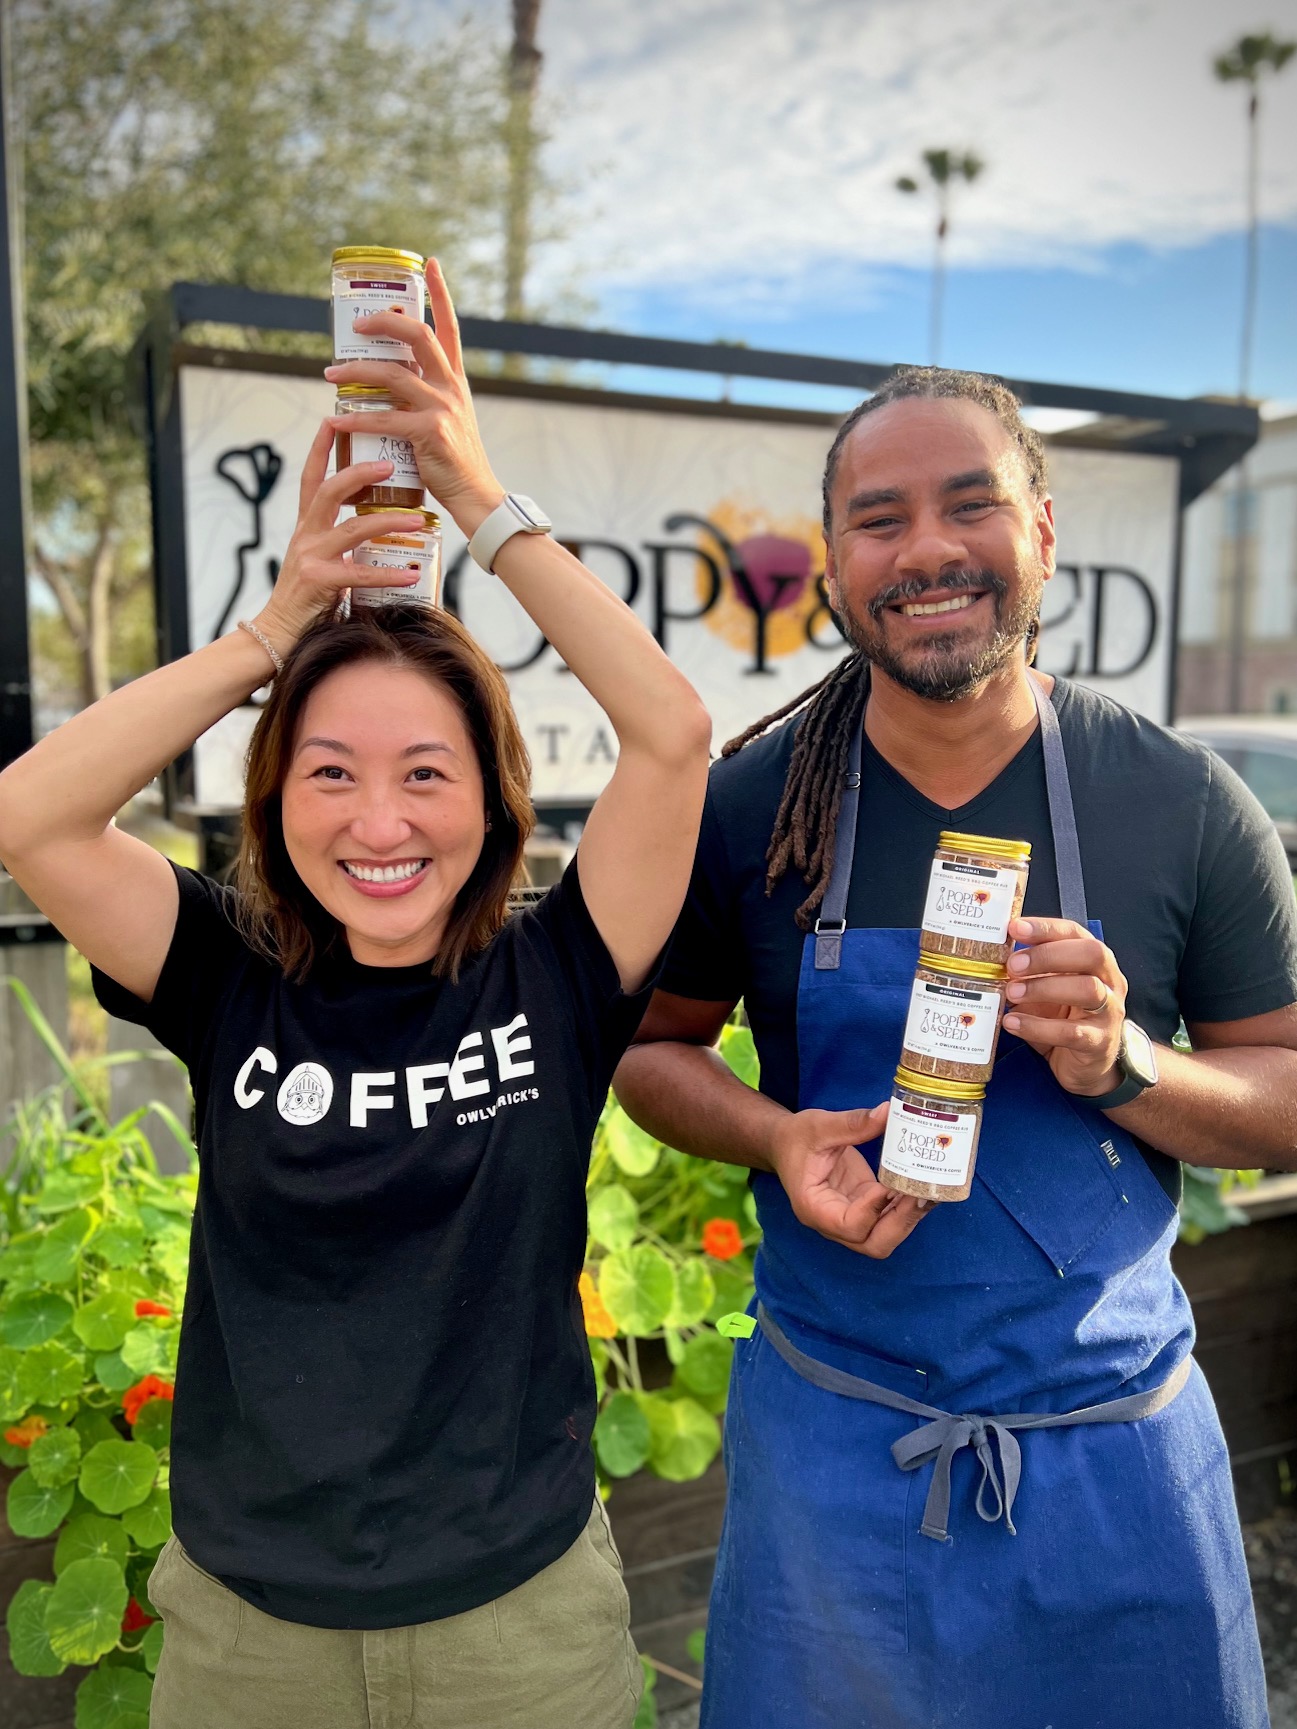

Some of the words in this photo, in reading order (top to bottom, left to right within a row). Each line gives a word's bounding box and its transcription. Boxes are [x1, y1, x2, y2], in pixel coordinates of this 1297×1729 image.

[397, 453, 417, 466] SEE
[955, 866, 980, 875] ORIGINAL
[951, 903, 984, 919] SEED
[939, 989, 966, 998] ORIGINAL
[937, 1026, 969, 1041] SEED
[233, 1013, 535, 1129] COFFEE
[456, 1087, 539, 1126] OWLVRICK'S
[914, 1147, 946, 1162] SEED
